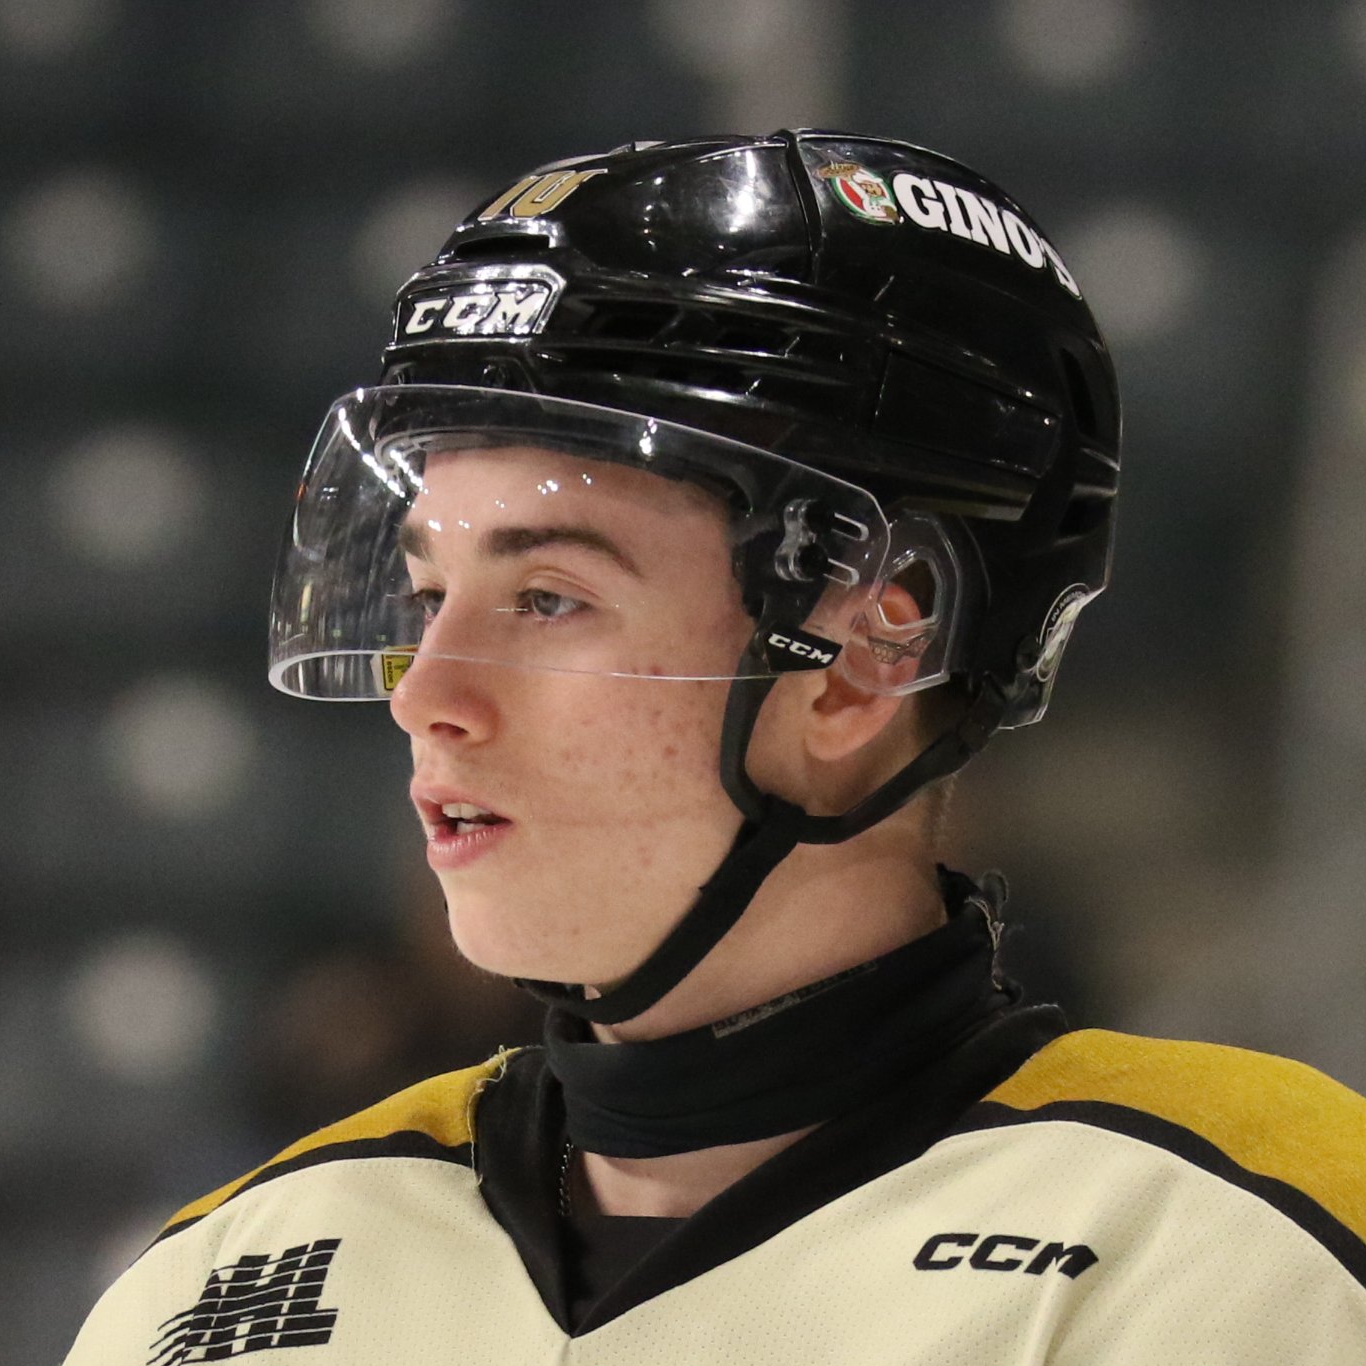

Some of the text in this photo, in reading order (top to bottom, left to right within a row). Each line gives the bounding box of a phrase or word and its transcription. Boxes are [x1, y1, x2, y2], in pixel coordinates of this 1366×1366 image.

[478, 168, 609, 222] 10
[405, 291, 549, 335] CCM
[768, 633, 834, 664] CCM
[912, 1233, 1100, 1281] CCM
